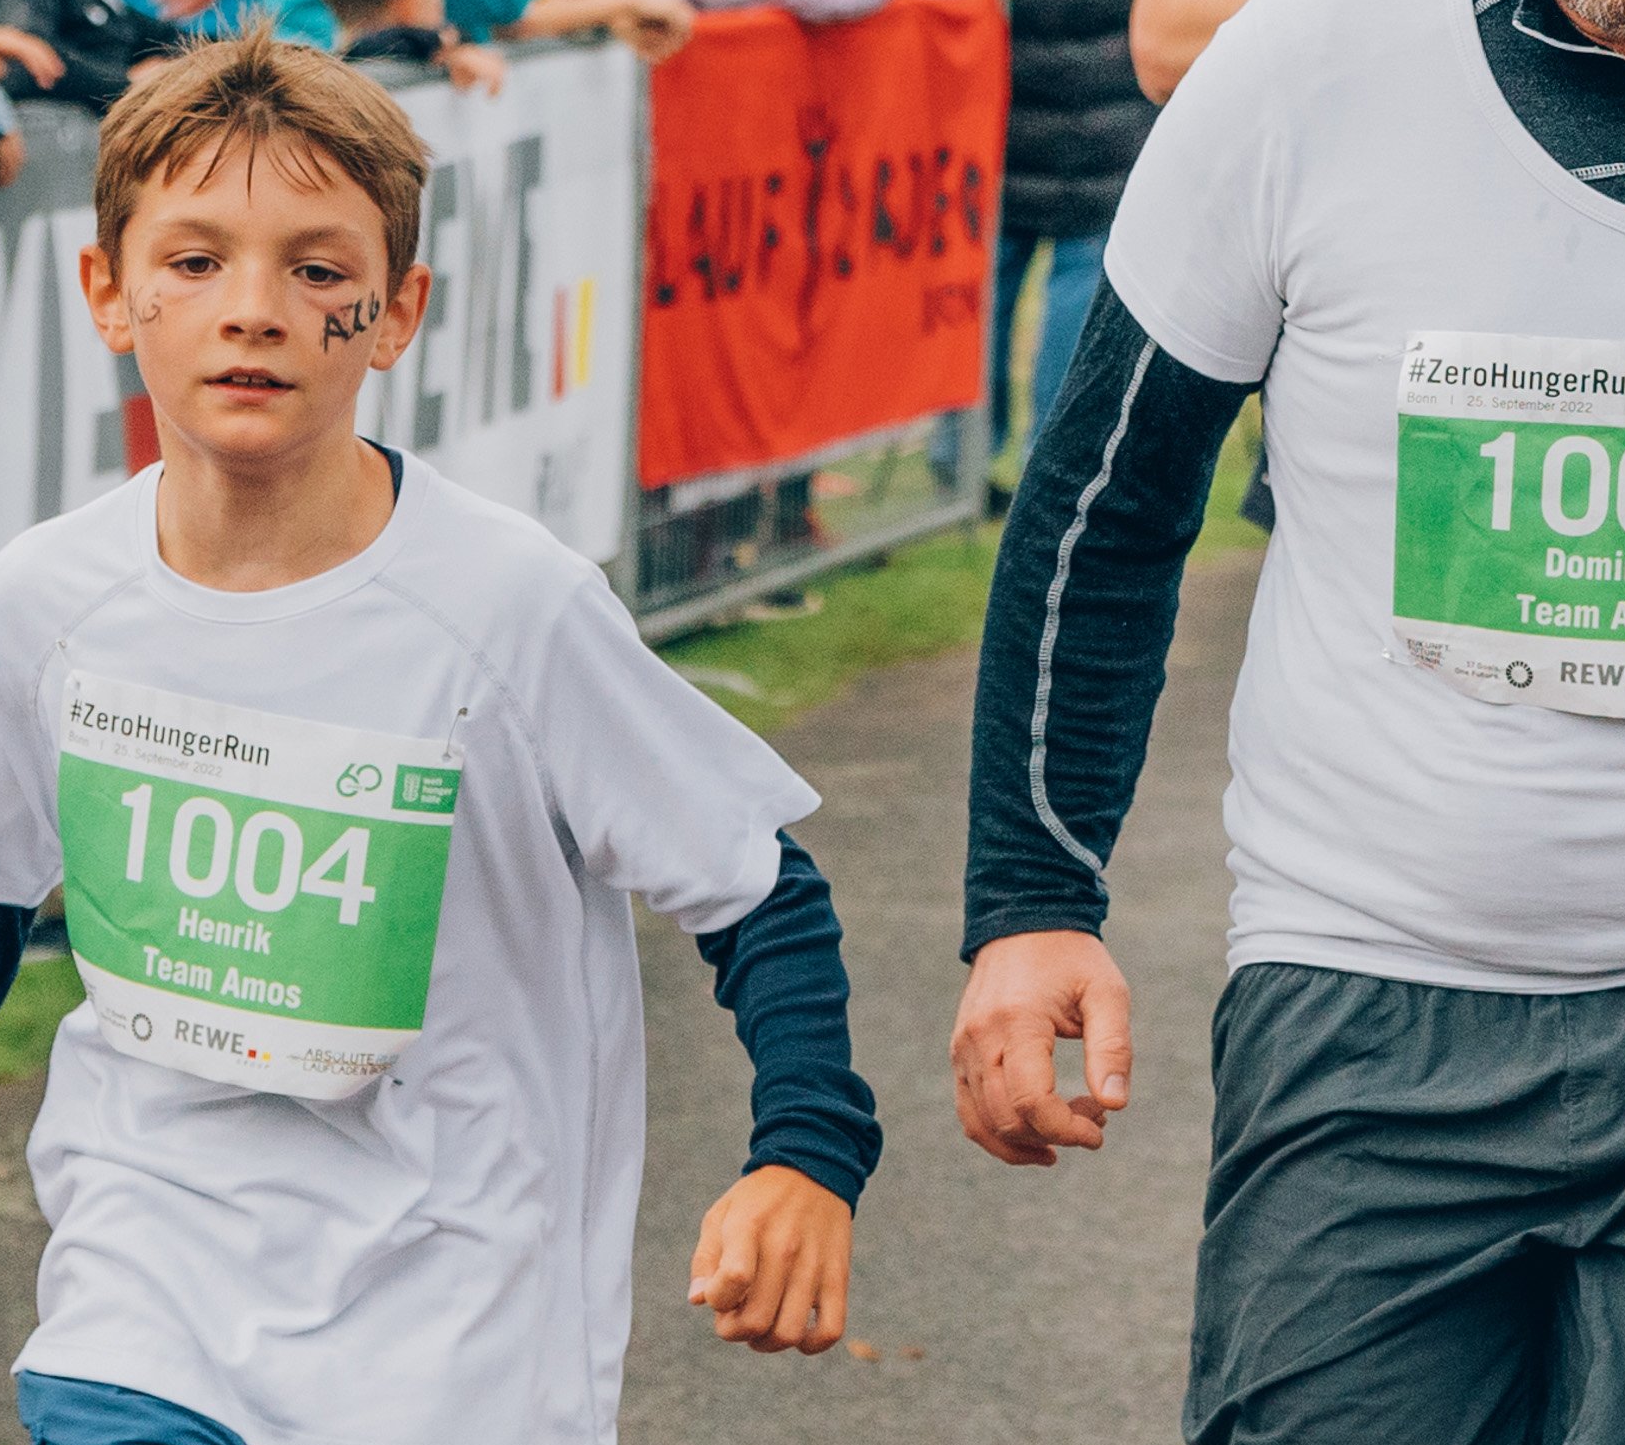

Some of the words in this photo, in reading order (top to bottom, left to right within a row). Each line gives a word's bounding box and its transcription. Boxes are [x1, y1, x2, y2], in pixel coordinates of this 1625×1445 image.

[1407, 392, 1437, 404] Bonn
[1467, 396, 1485, 407] 25.
[1492, 397, 1555, 411] September
[1560, 401, 1593, 414] 2022
[1516, 593, 1600, 631] Team
[69, 698, 270, 766] #ZeroHungerRun
[121, 783, 376, 926] 1004
[178, 907, 271, 955] Henrik
[143, 945, 213, 992] Team
[219, 966, 302, 1009] Amos
[175, 1018, 245, 1055] REWE
[304, 1048, 375, 1065] ABSOLUTE
